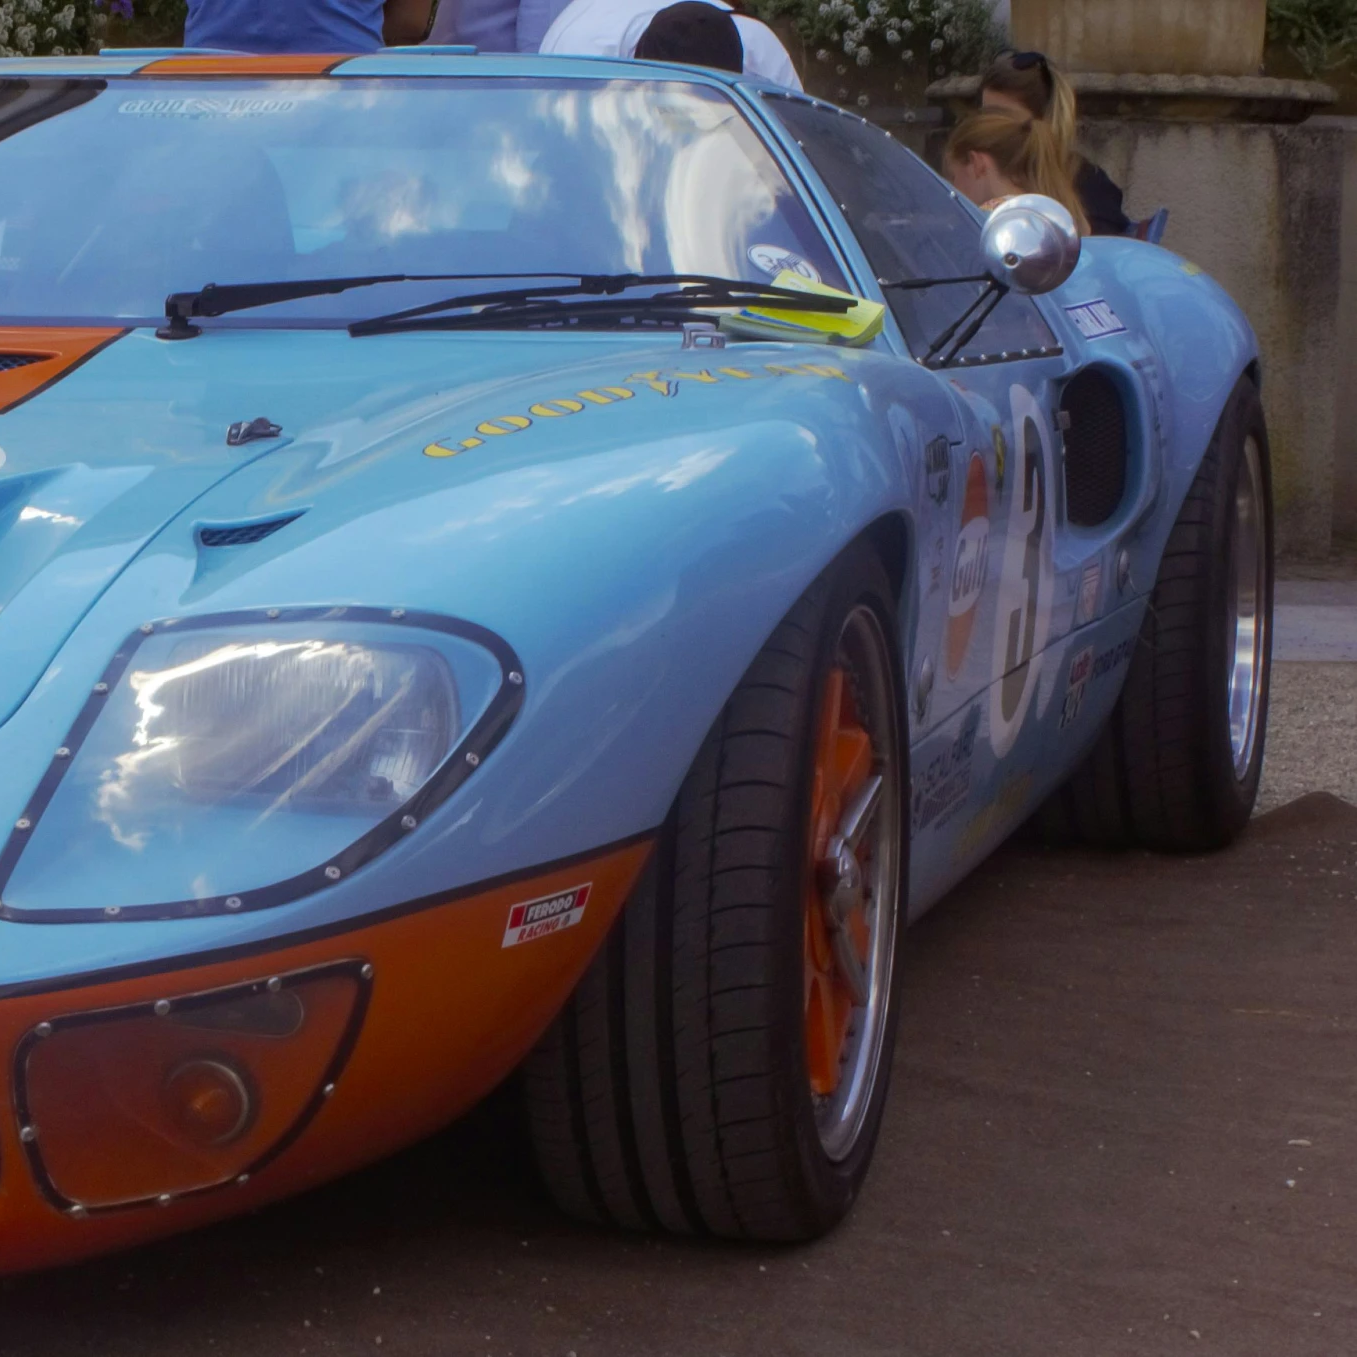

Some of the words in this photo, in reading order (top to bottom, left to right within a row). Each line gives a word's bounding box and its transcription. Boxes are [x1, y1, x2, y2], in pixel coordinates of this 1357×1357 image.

[1000, 415, 1046, 723] 3
[526, 895, 574, 921] FERODO
[517, 917, 561, 942] RACING
